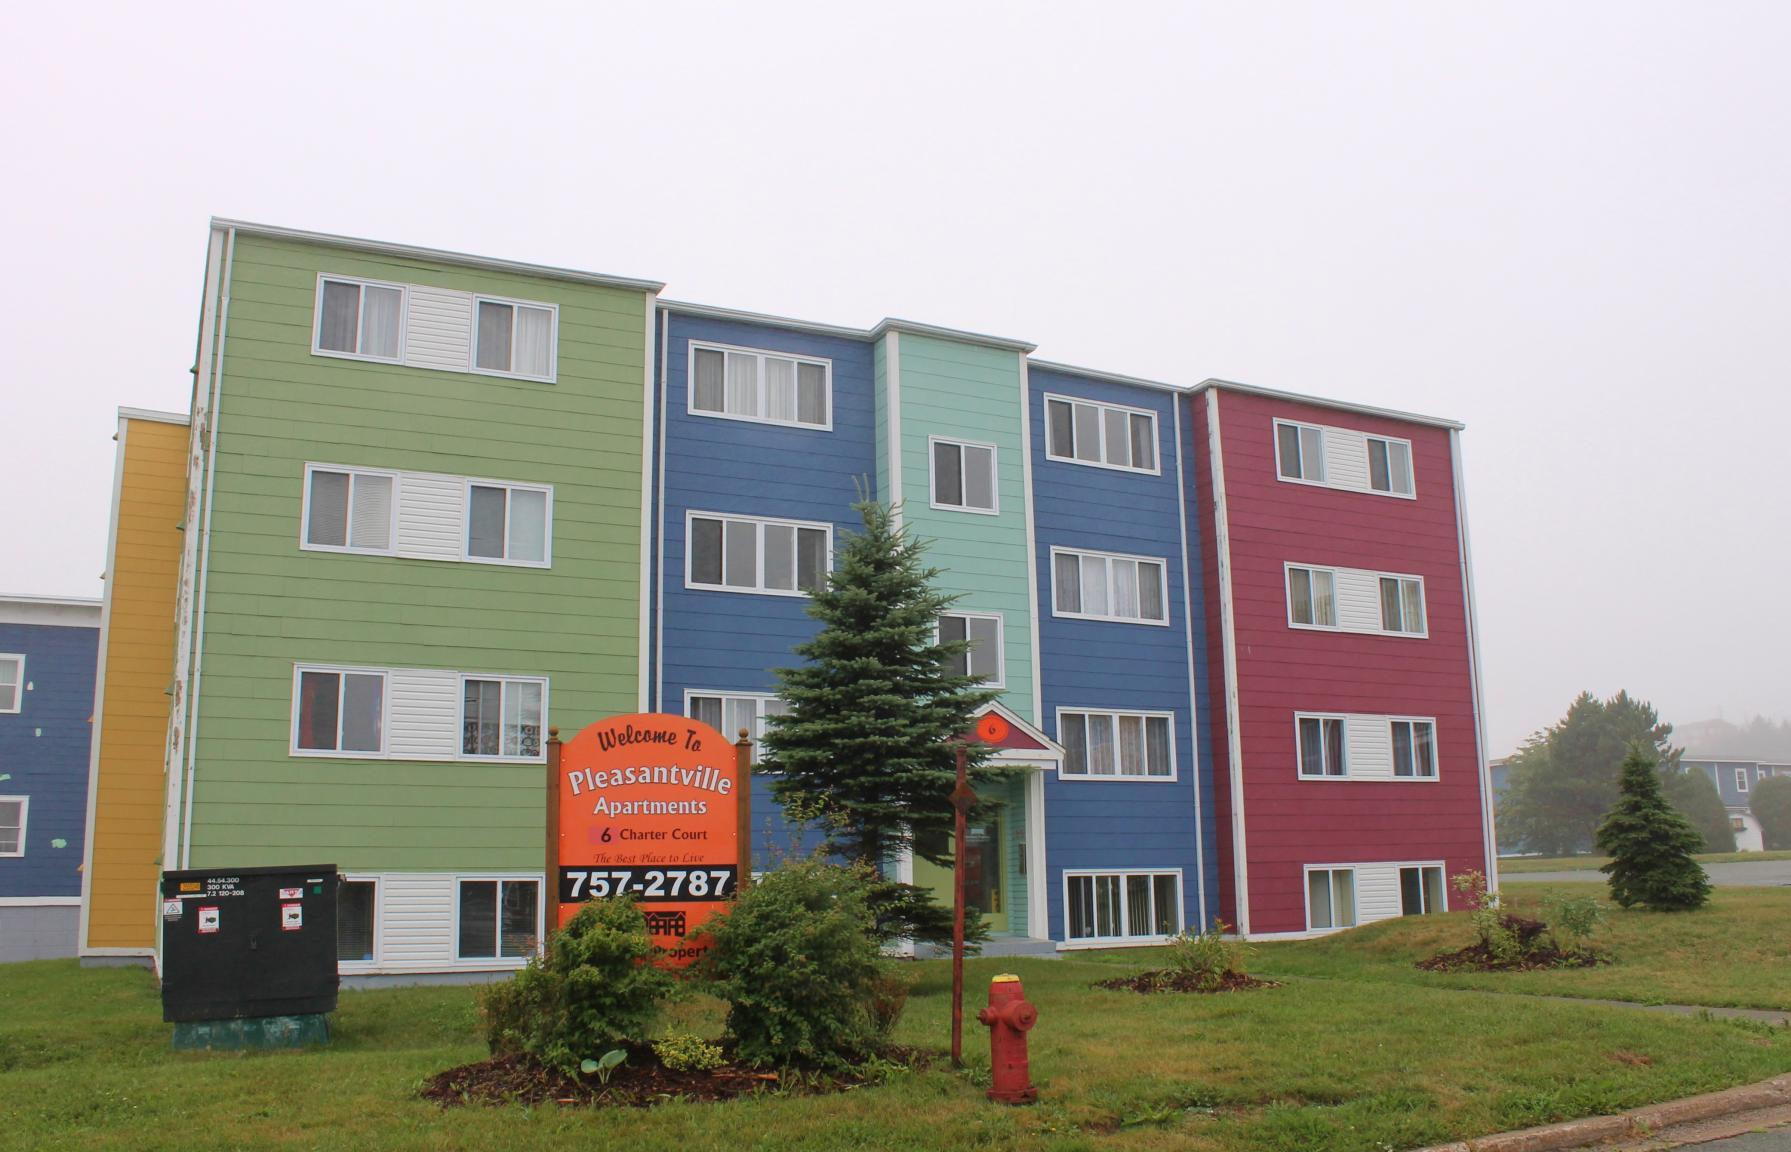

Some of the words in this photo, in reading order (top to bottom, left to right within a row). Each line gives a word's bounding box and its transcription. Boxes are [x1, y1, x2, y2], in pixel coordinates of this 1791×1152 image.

[597, 724, 677, 752] Welcome
[684, 729, 702, 752] To
[568, 764, 732, 796] Pleasantville
[593, 796, 707, 818] Apartments
[601, 827, 612, 843] 6
[619, 828, 668, 841] Charter
[671, 828, 708, 841] Court
[593, 852, 611, 864] The
[615, 853, 636, 864] Best
[640, 852, 667, 864] Place
[669, 853, 679, 863] to
[682, 852, 705, 863] Live
[566, 870, 731, 898] 757-2787
